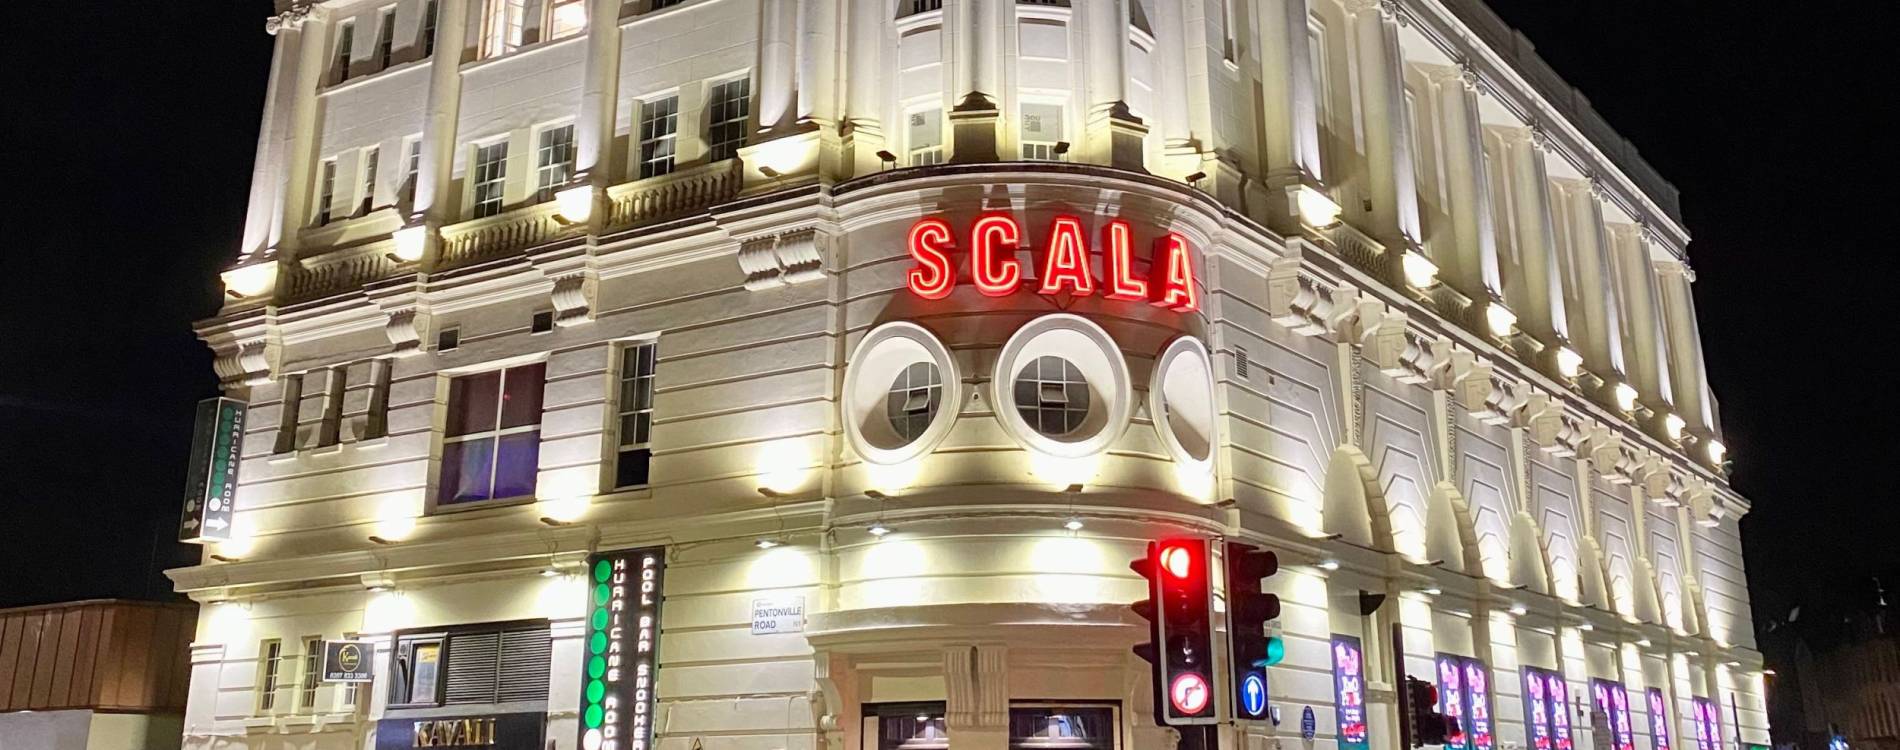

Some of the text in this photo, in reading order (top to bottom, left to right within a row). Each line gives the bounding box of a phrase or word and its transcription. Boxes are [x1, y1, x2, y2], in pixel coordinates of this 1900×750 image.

[907, 213, 1199, 312] SCALA
[221, 410, 242, 512] HURRICANE ROOM
[602, 559, 624, 750] HURRICANE ROOM
[632, 557, 656, 750] POOL BAR SNOOKER
[754, 620, 776, 630] ROAD
[755, 606, 801, 618] PENTONVILLE
